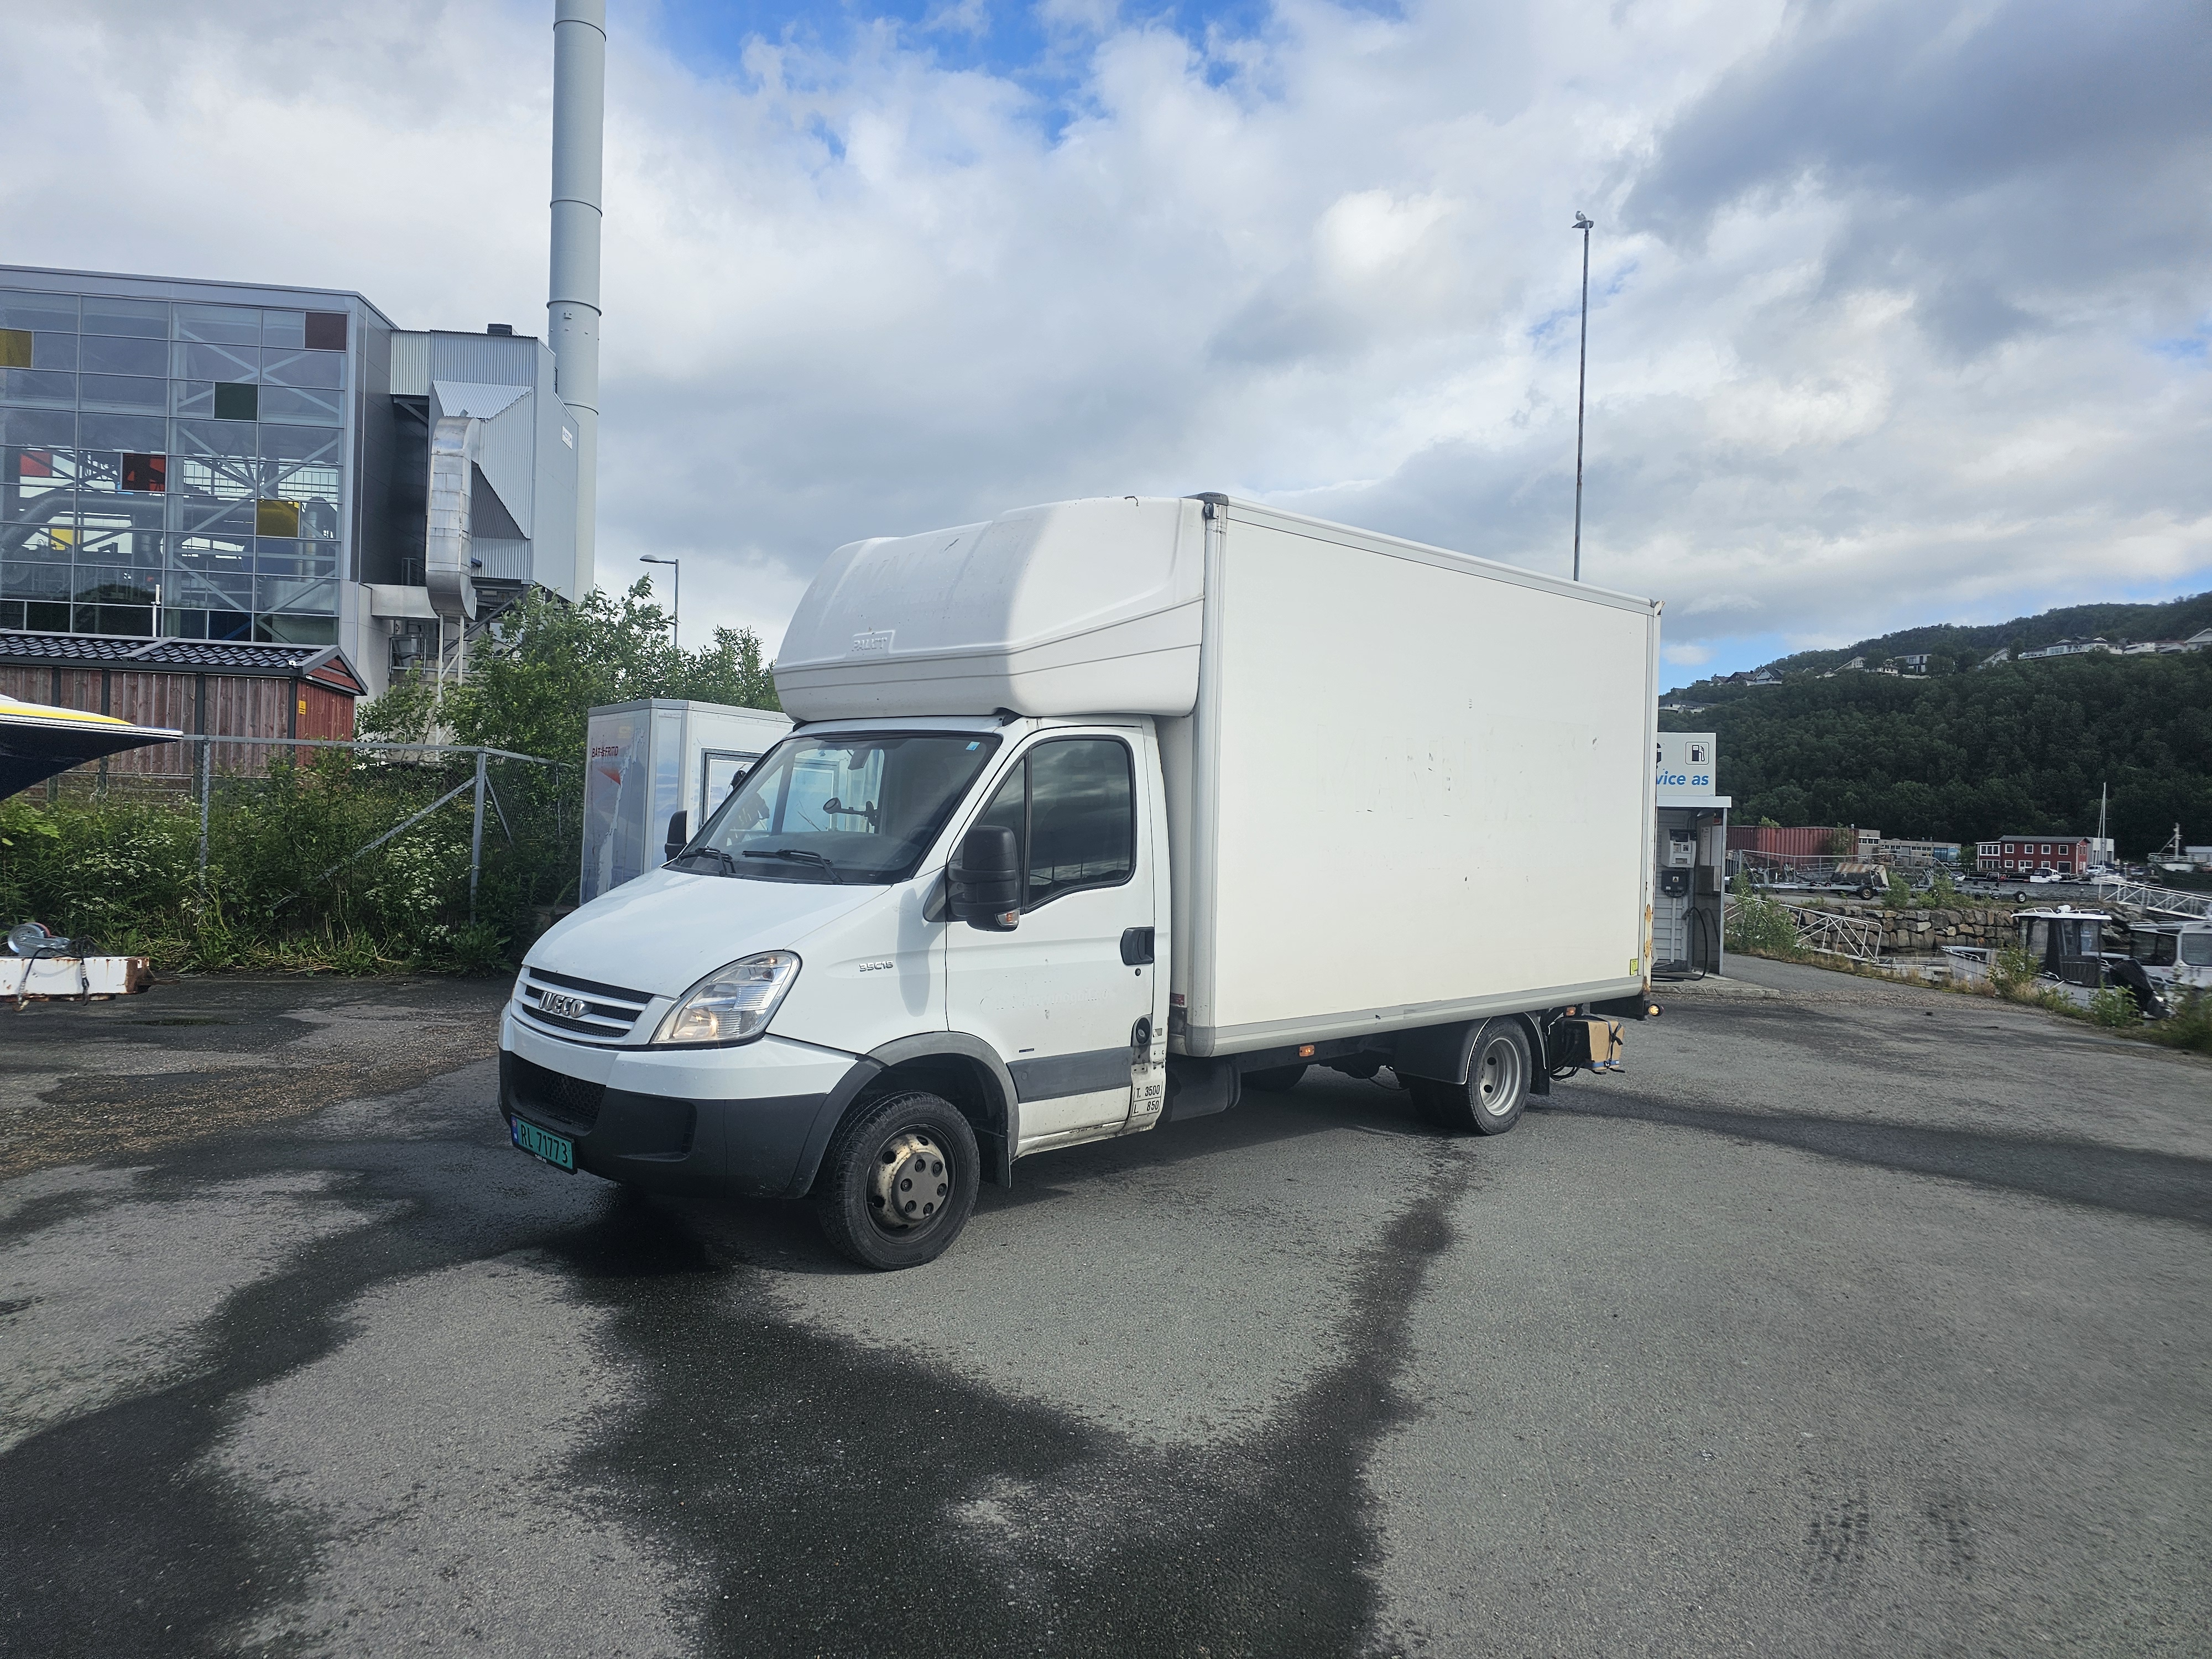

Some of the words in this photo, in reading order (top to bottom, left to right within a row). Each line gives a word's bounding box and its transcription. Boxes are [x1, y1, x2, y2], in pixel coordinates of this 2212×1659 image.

[1692, 775, 1709, 785] as
[539, 991, 585, 1018] IVECO
[1145, 1084, 1160, 1097] 3500
[1146, 1100, 1160, 1112] 850
[520, 1124, 533, 1149] RL
[536, 1131, 568, 1164] 71773
